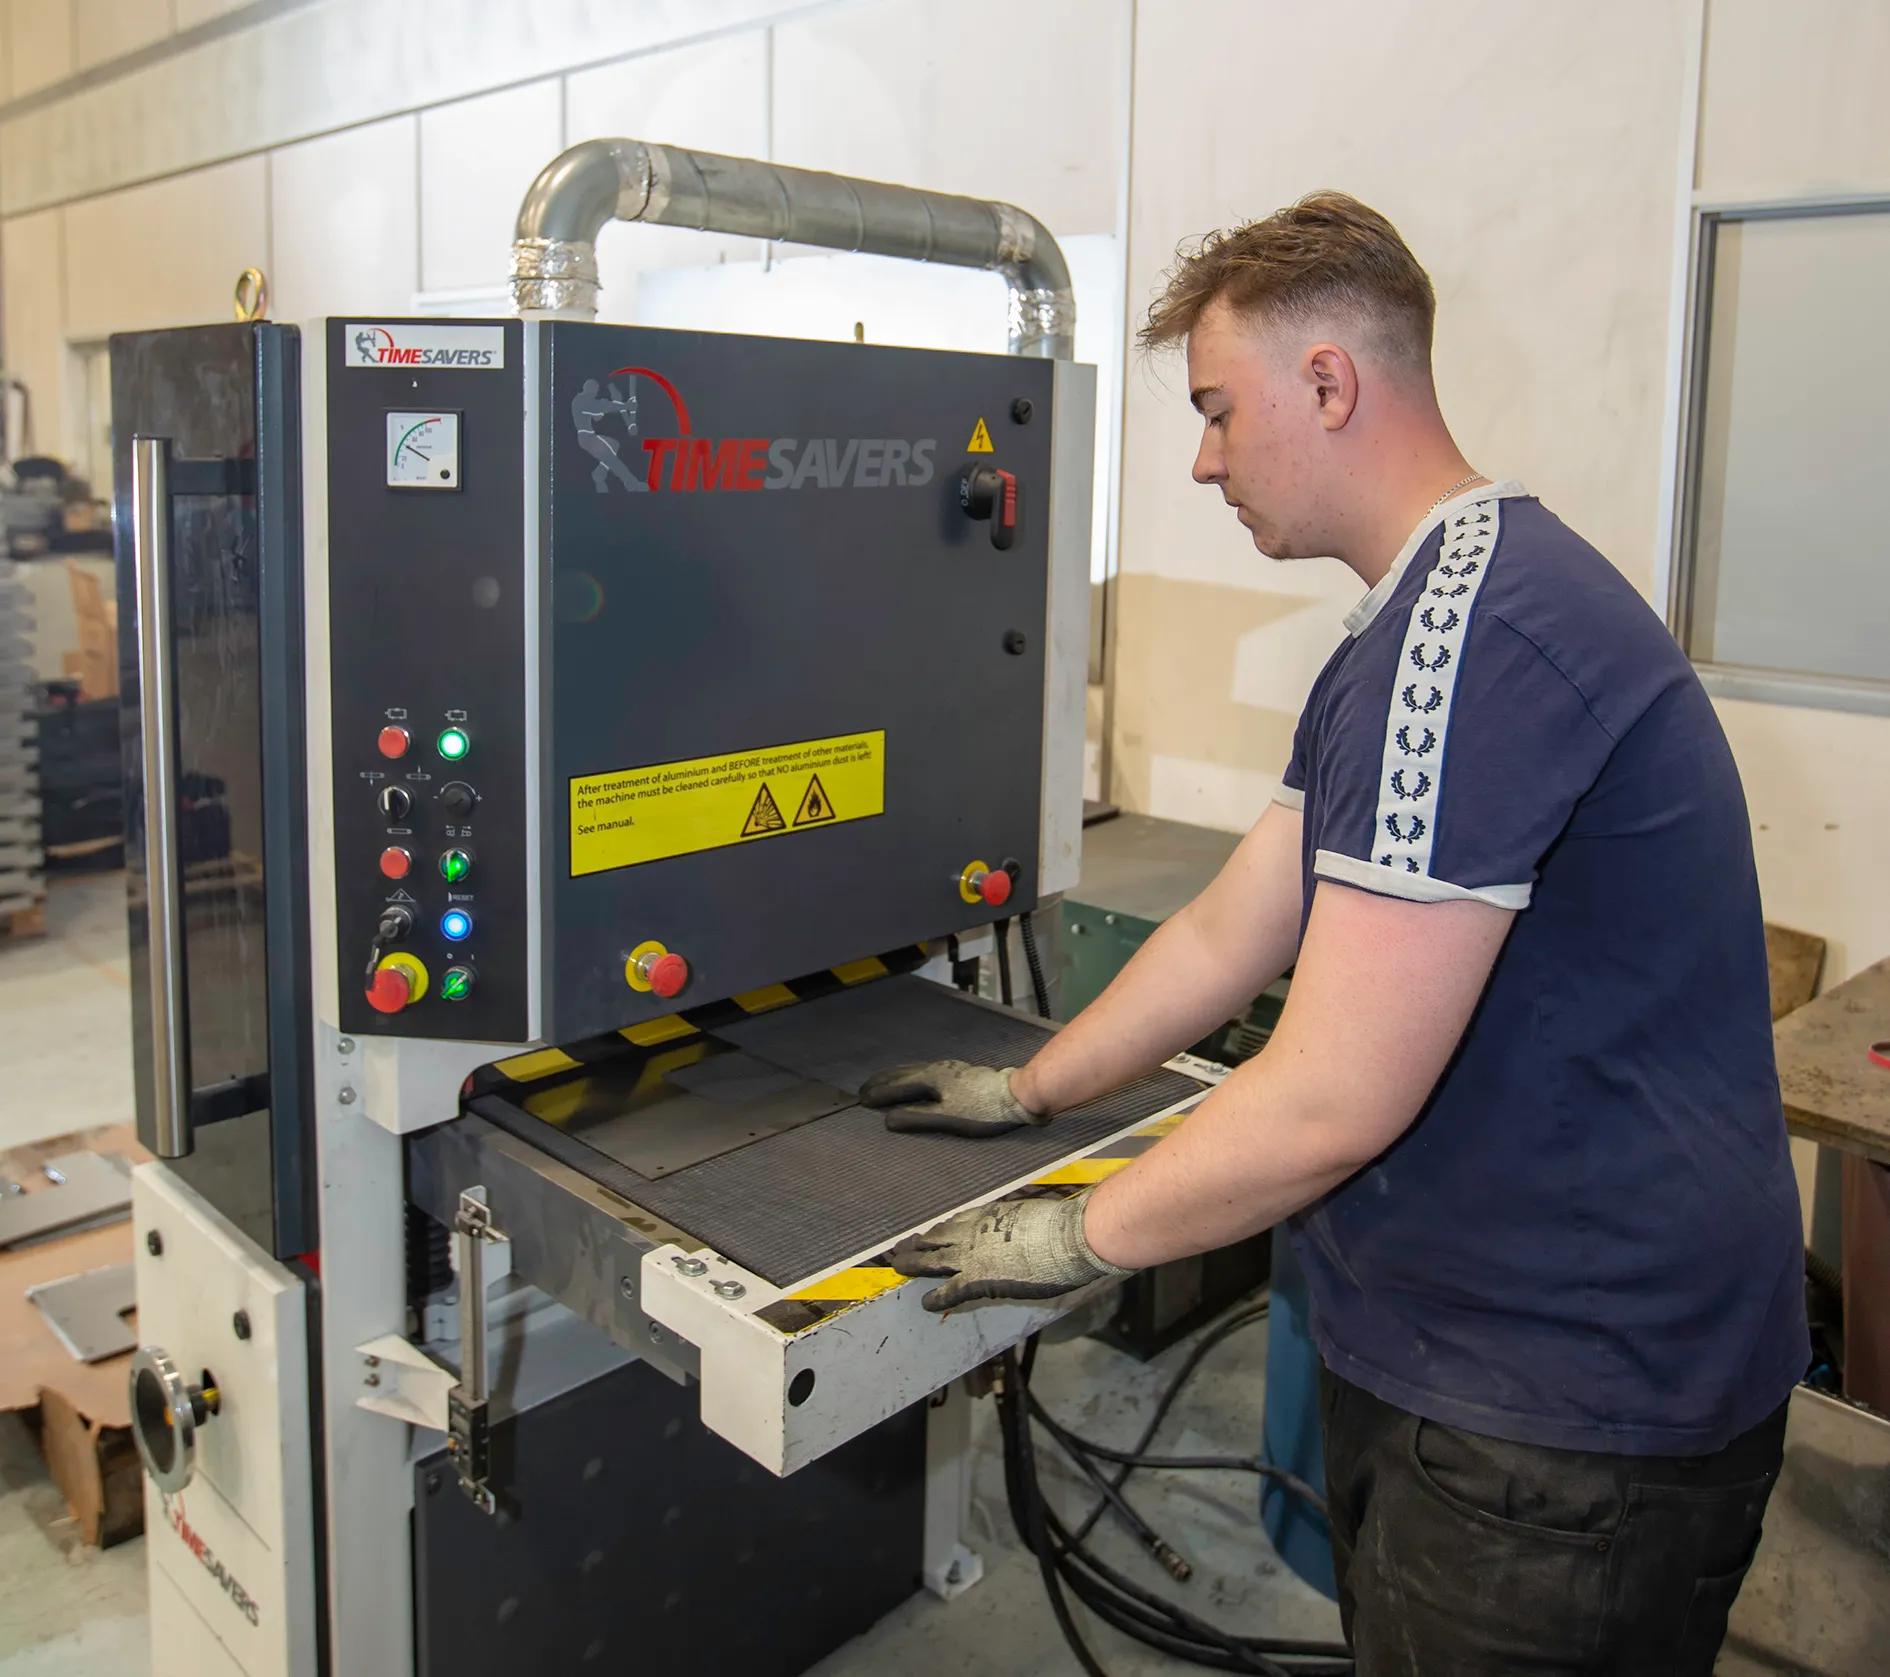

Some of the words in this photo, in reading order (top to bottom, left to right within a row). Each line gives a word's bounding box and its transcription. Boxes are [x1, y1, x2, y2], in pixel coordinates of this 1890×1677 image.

[377, 348, 492, 365] TIMESAVERS
[642, 438, 938, 492] TIMESAVERS
[577, 784, 601, 796] After
[603, 776, 650, 791] treatment
[651, 773, 661, 784] of
[662, 767, 709, 782] aluminium
[711, 762, 727, 774] and
[729, 757, 760, 771] BEFORE
[762, 751, 801, 765] treatment
[802, 748, 811, 758] of
[812, 747, 832, 757] other
[577, 798, 594, 809] the
[595, 792, 636, 806] machine
[637, 788, 660, 799] must
[662, 784, 673, 794] be
[675, 778, 709, 793] cleaned
[711, 771, 745, 786] carefully
[748, 771, 757, 779] so
[758, 768, 774, 777] that
[776, 764, 789, 774] NO
[790, 759, 831, 772] aluminium
[832, 755, 848, 765] dust
[850, 754, 856, 762] is
[577, 825, 595, 835] See
[597, 816, 635, 832] manual.
